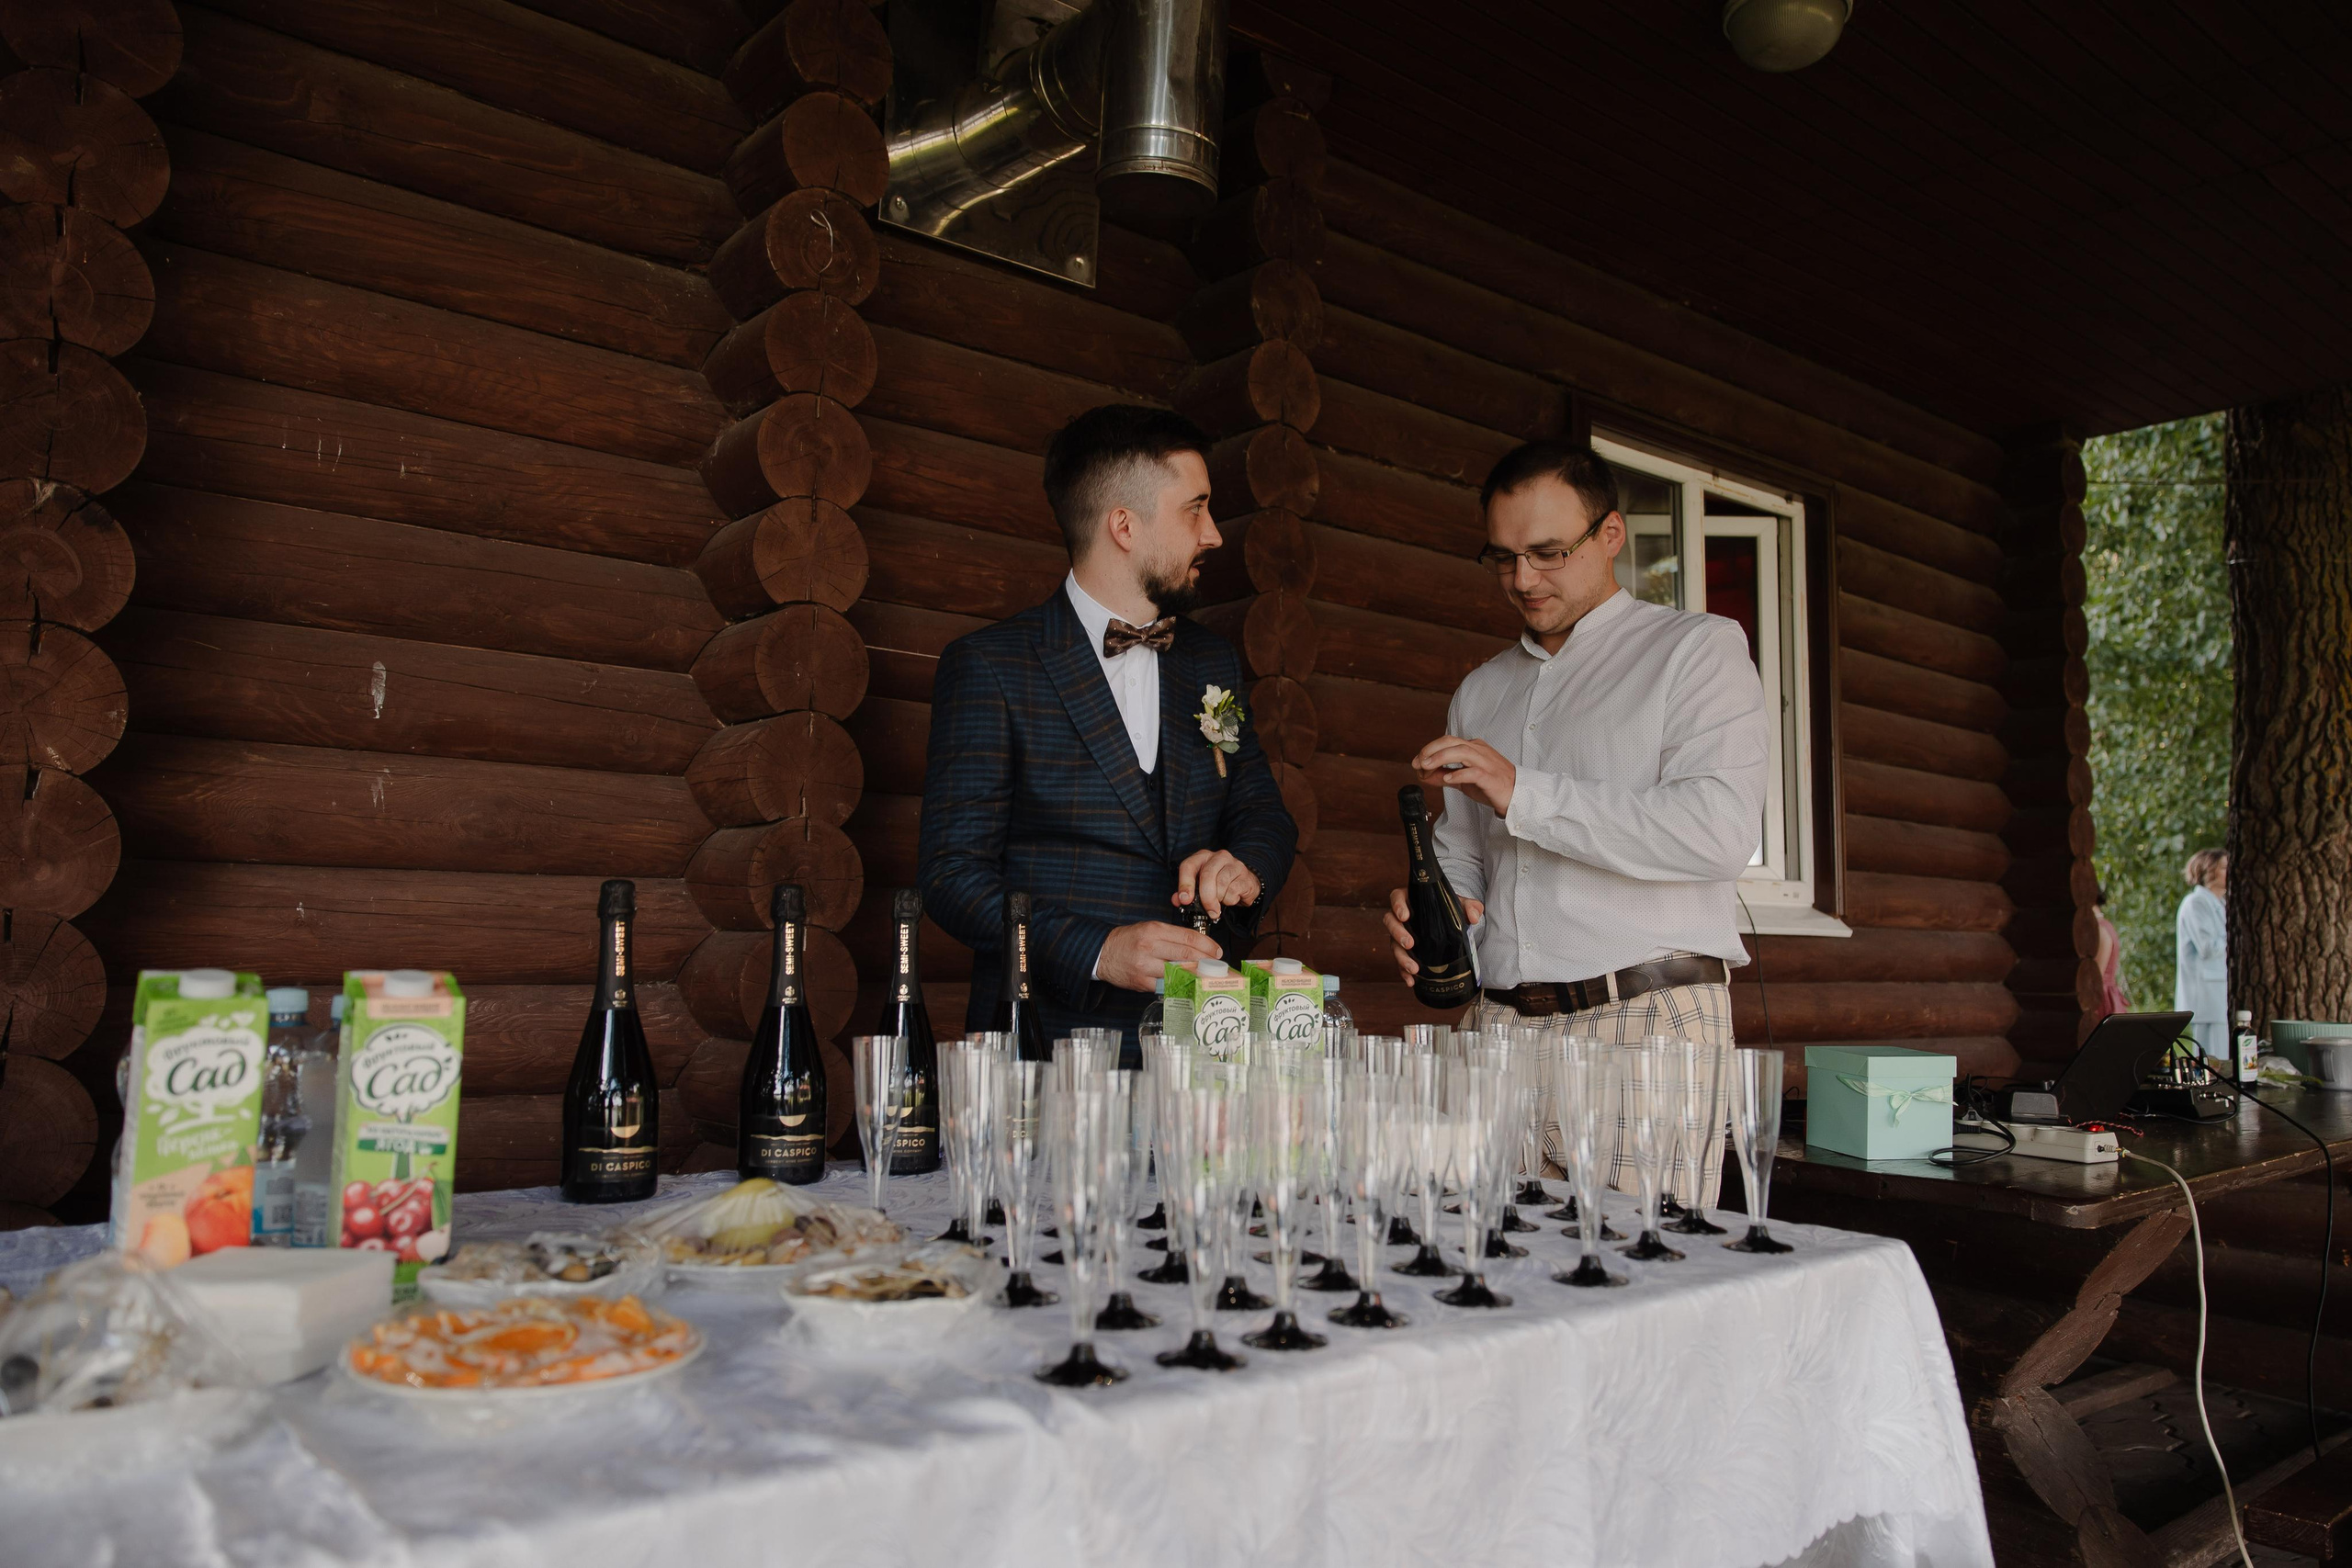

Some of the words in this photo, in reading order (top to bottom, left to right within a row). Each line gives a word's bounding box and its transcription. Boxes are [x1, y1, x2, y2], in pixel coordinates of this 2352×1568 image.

[785, 921, 795, 976] SEMI-SWEET
[899, 923, 910, 974] SEMI-SWEET
[1018, 923, 1027, 973] SEMI-SWEET
[1429, 982, 1465, 993] CASPICO
[167, 1048, 247, 1096] Сад
[367, 1055, 443, 1100] Сад
[591, 1163, 603, 1171] DI
[605, 1160, 651, 1172] CASPICO
[761, 1148, 772, 1157] DI
[774, 1147, 817, 1157] CASPICO
